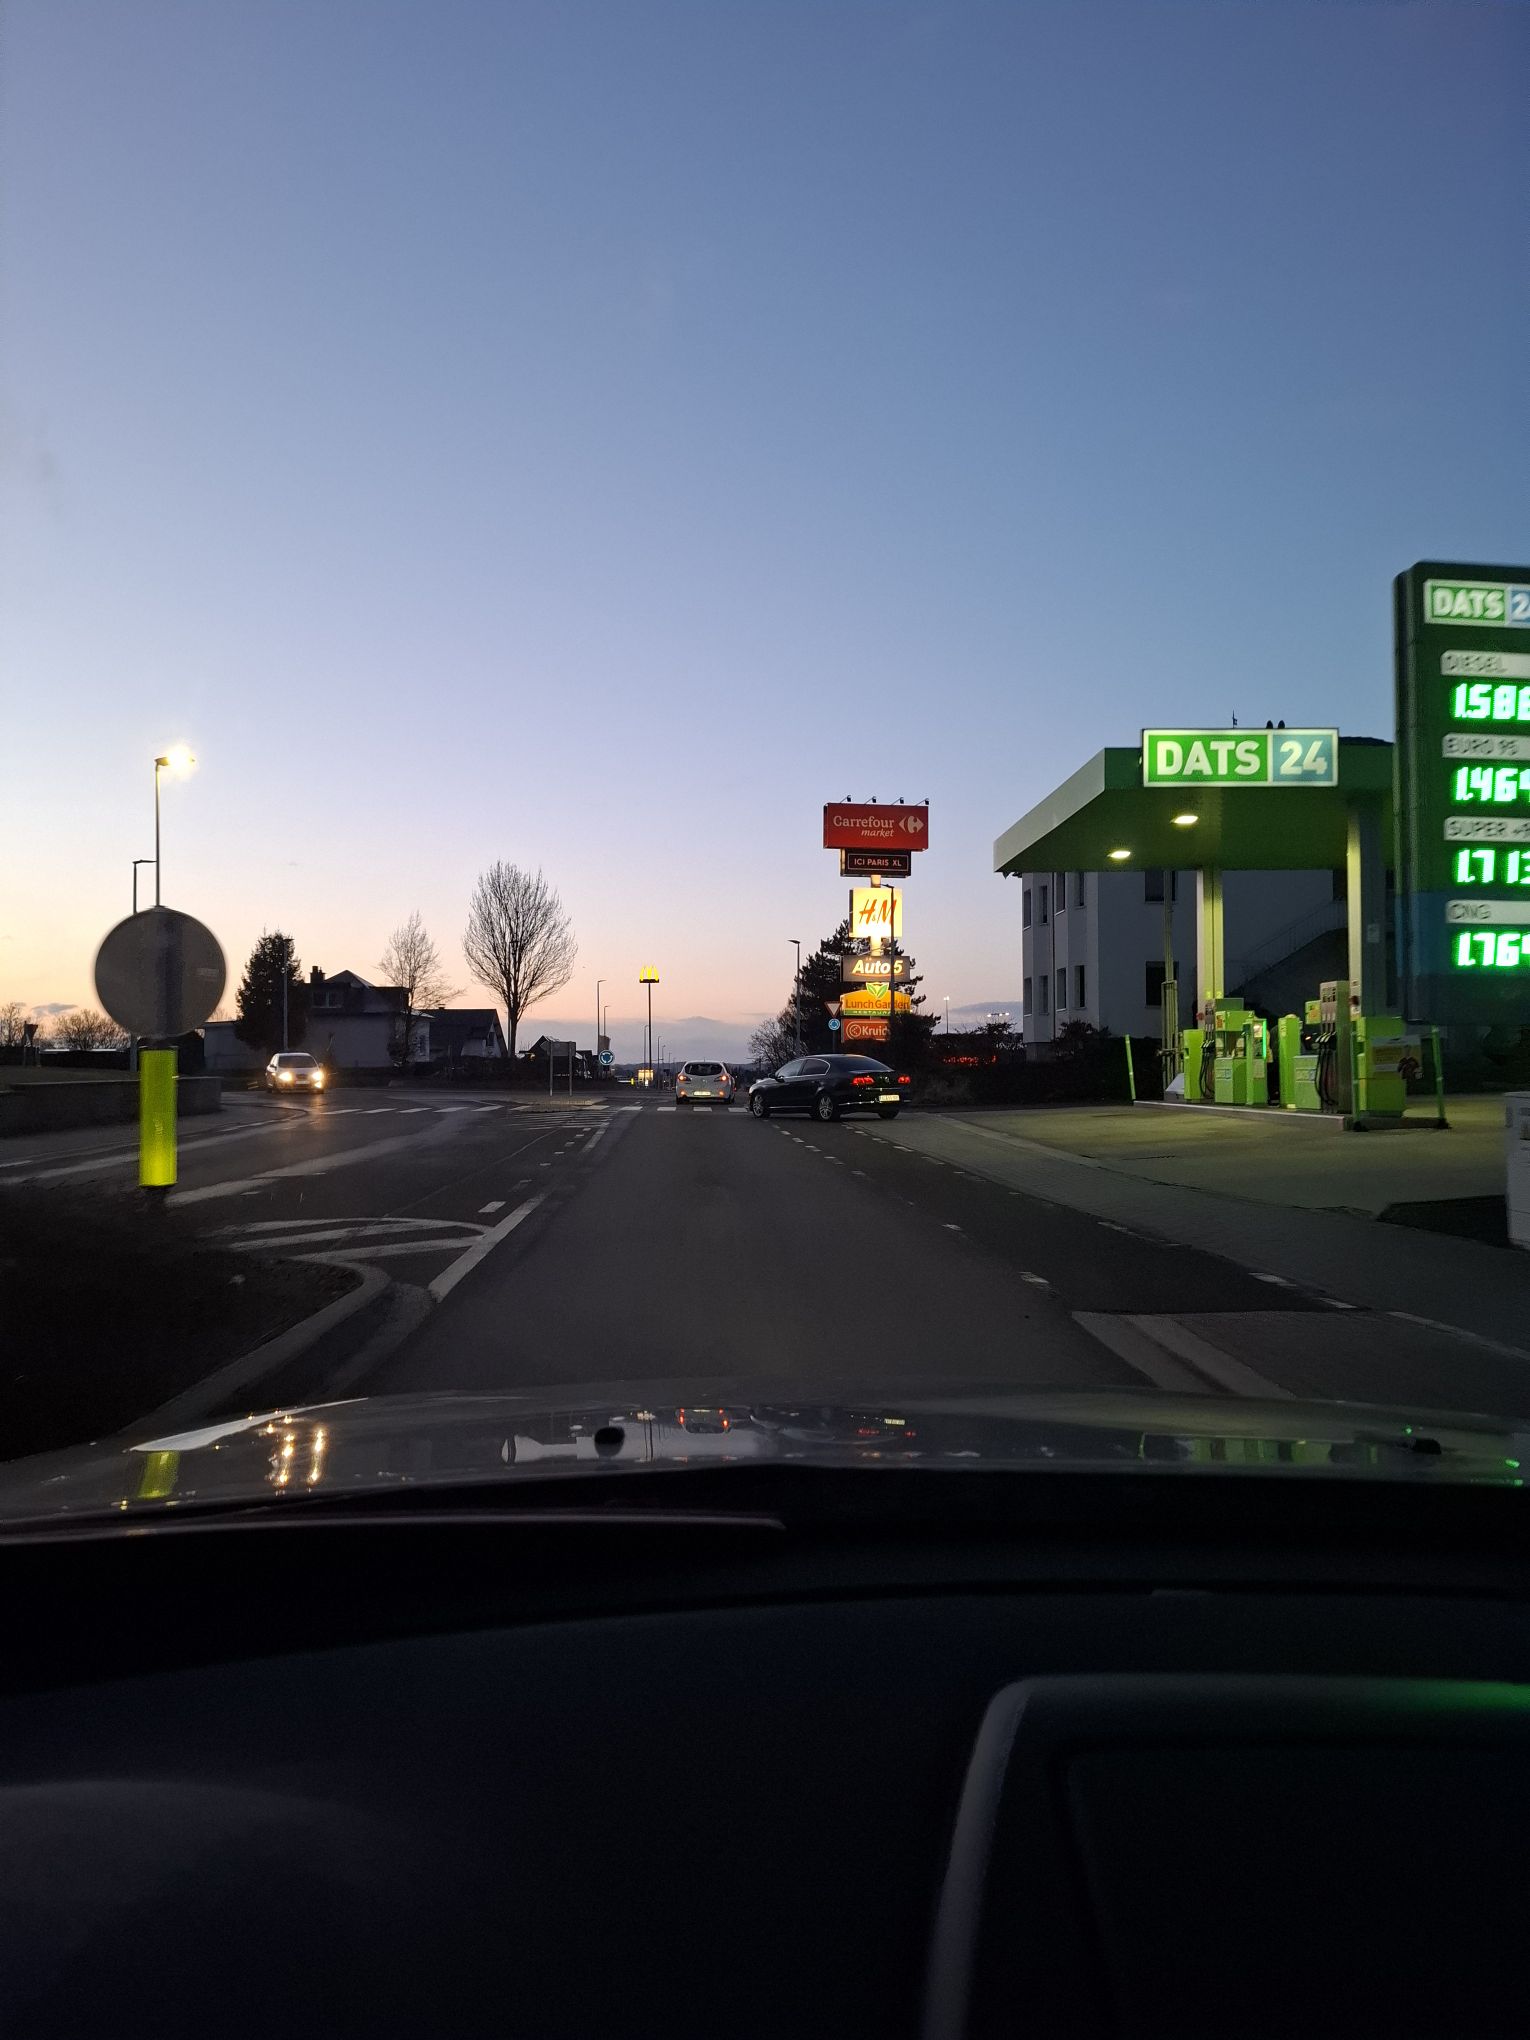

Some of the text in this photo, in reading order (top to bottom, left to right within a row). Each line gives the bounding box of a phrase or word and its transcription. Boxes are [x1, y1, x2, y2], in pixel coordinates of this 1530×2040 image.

[1433, 587, 1530, 620] DATS 2
[1442, 655, 1507, 673] DIESEL
[1445, 737, 1493, 755] EURO
[1156, 740, 1328, 776] DATS 24
[833, 815, 895, 828] Carrefour
[1447, 820, 1506, 837] SUPER
[860, 828, 894, 838] market
[854, 858, 902, 867] ICI PARIS XL
[859, 899, 897, 925] H&M
[1448, 903, 1491, 920] CNG
[846, 1000, 873, 1009] Lunch
[862, 1025, 888, 1036] Kruid
